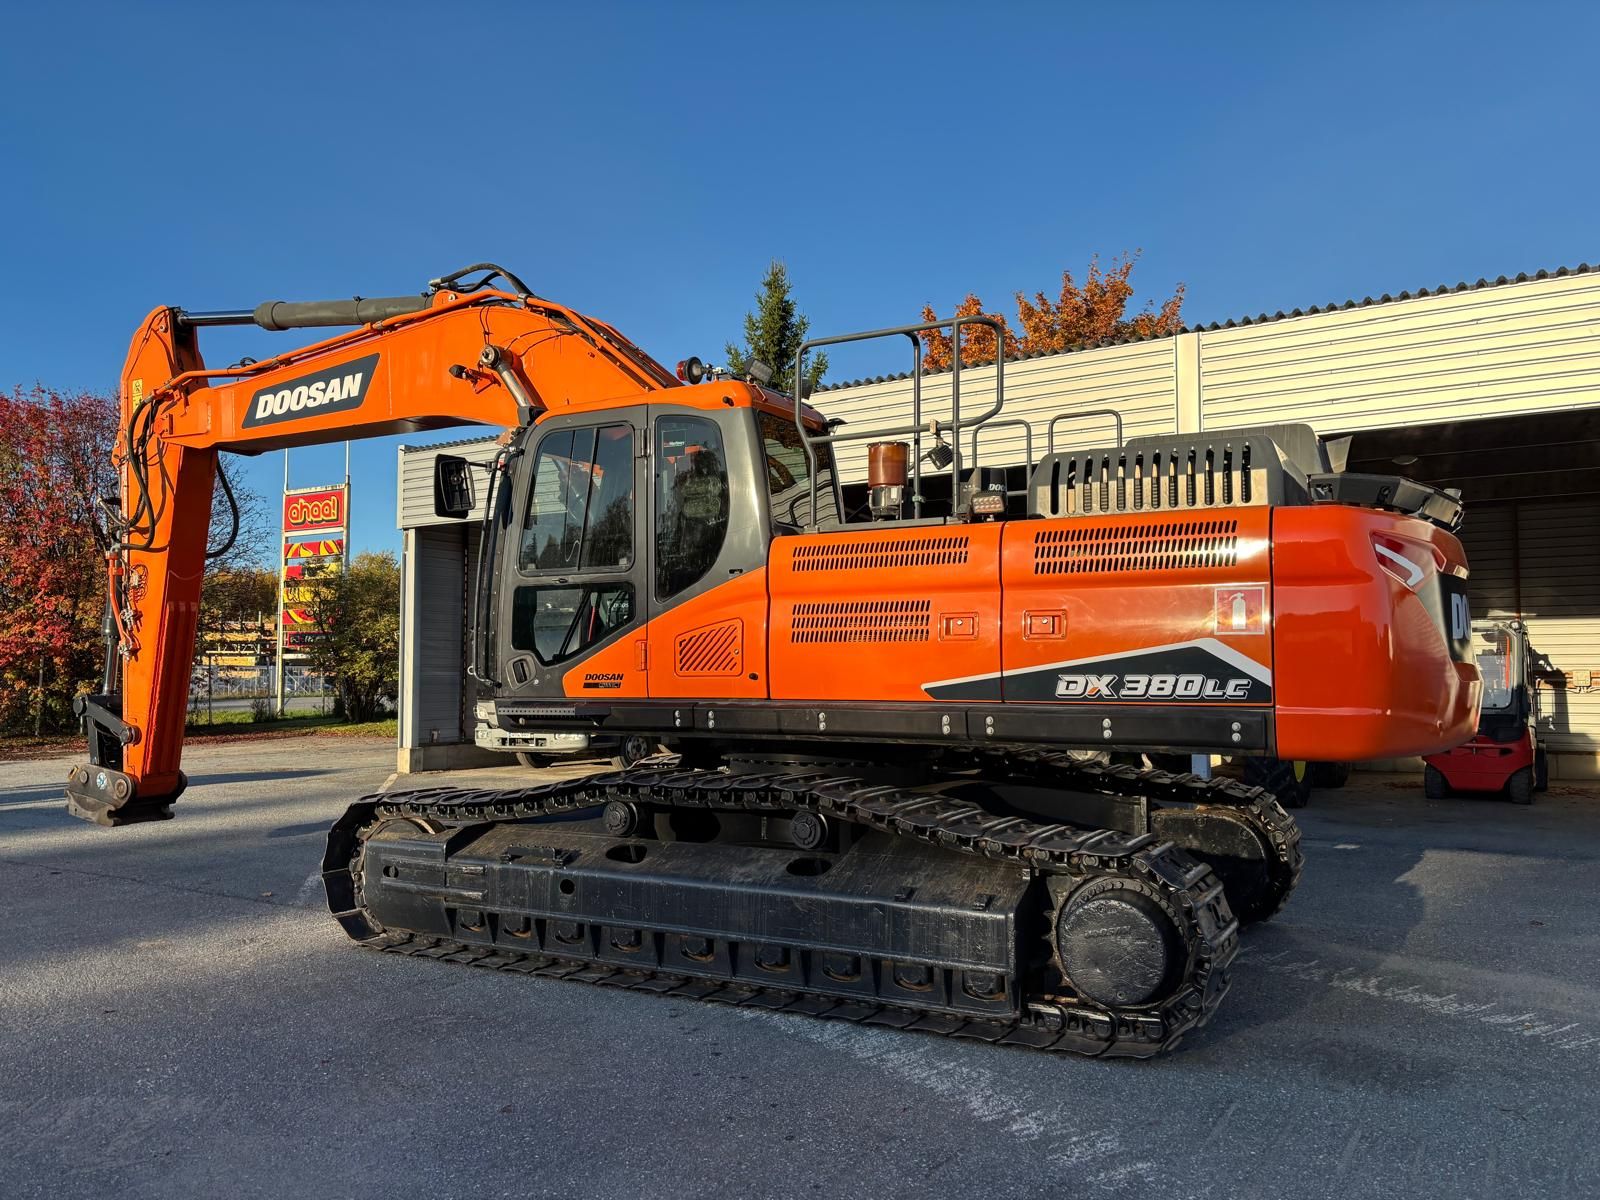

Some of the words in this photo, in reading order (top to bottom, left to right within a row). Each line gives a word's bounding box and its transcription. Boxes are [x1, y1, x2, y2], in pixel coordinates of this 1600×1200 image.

[255, 372, 363, 420] DOOSAN
[584, 673, 625, 681] DOOSAN
[1055, 674, 1119, 699] DX
